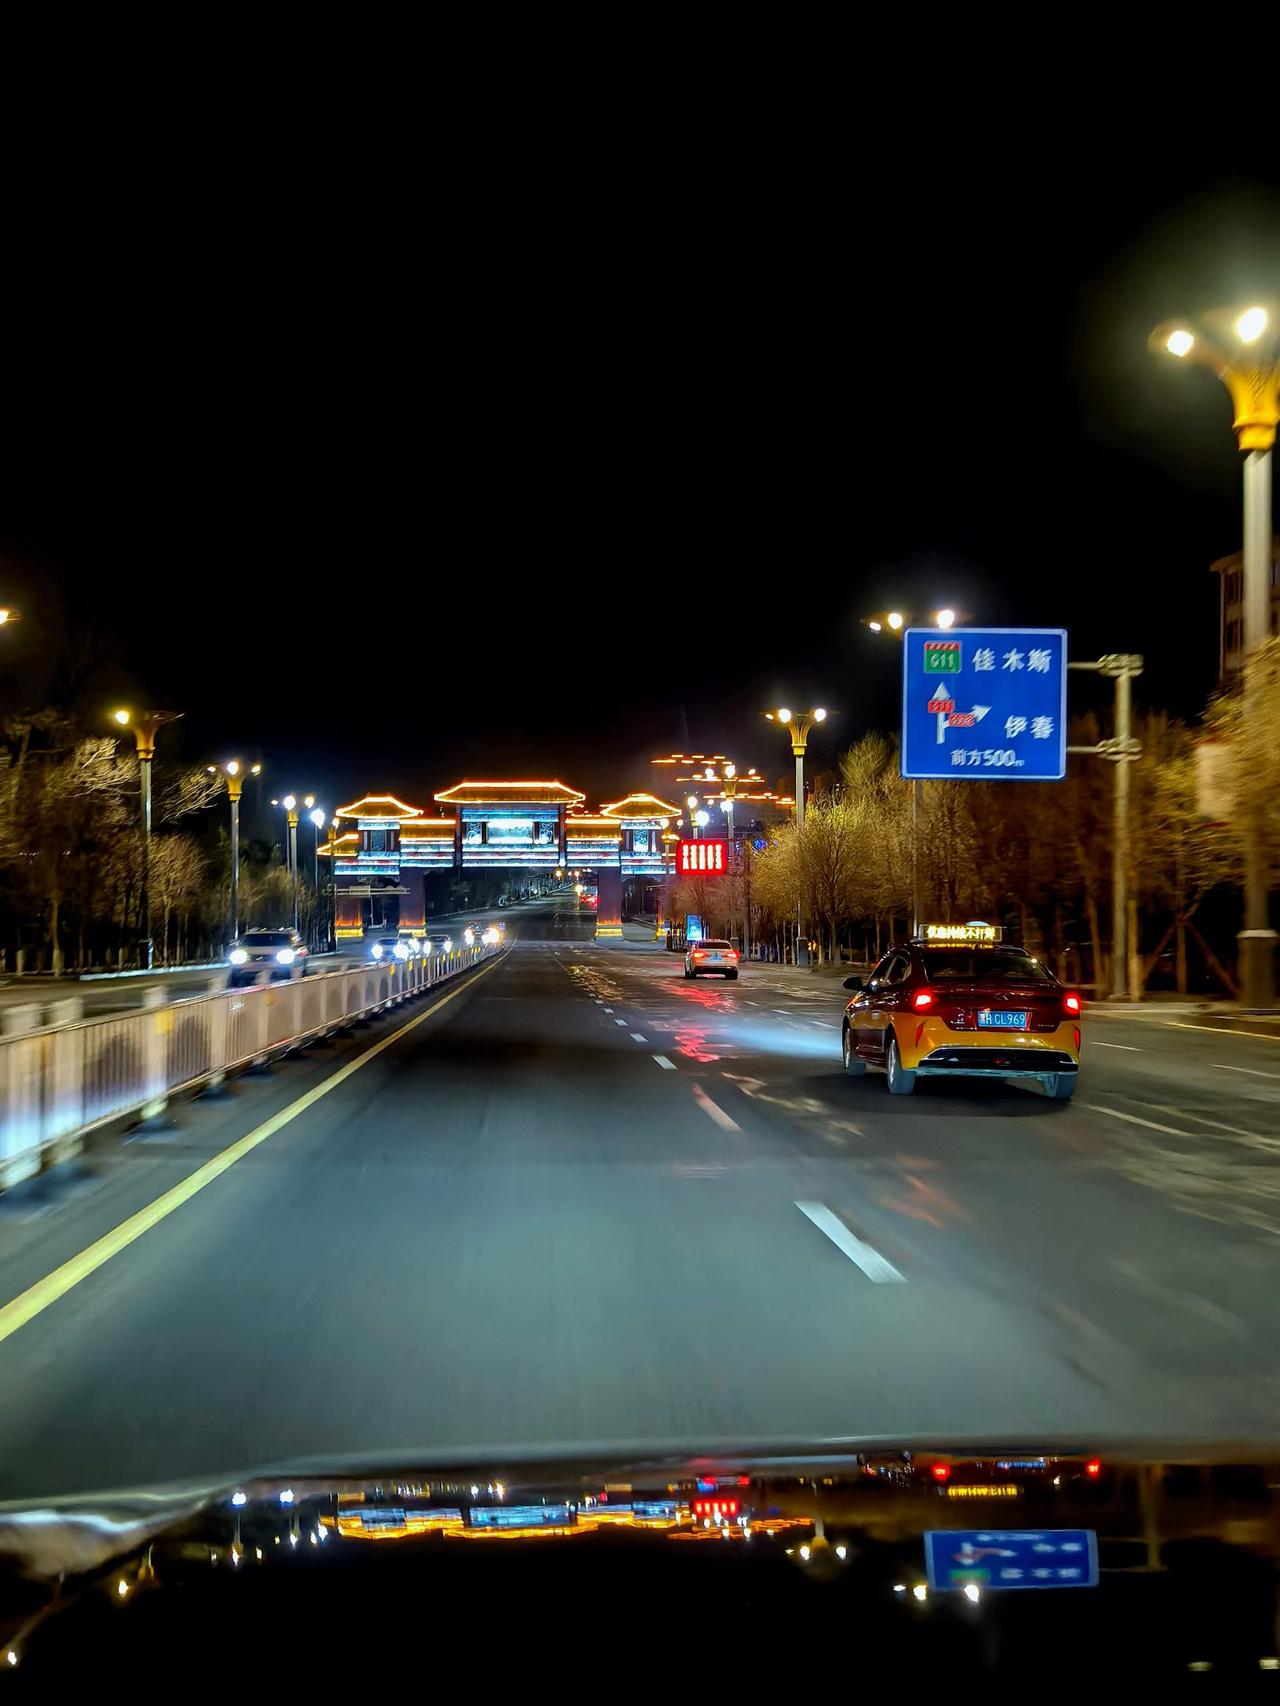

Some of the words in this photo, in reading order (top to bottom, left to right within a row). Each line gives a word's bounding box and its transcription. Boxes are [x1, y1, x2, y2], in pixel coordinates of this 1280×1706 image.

[930, 653, 955, 668] G11
[972, 647, 1052, 674] 佳木斯
[1004, 715, 1055, 739] 伊春
